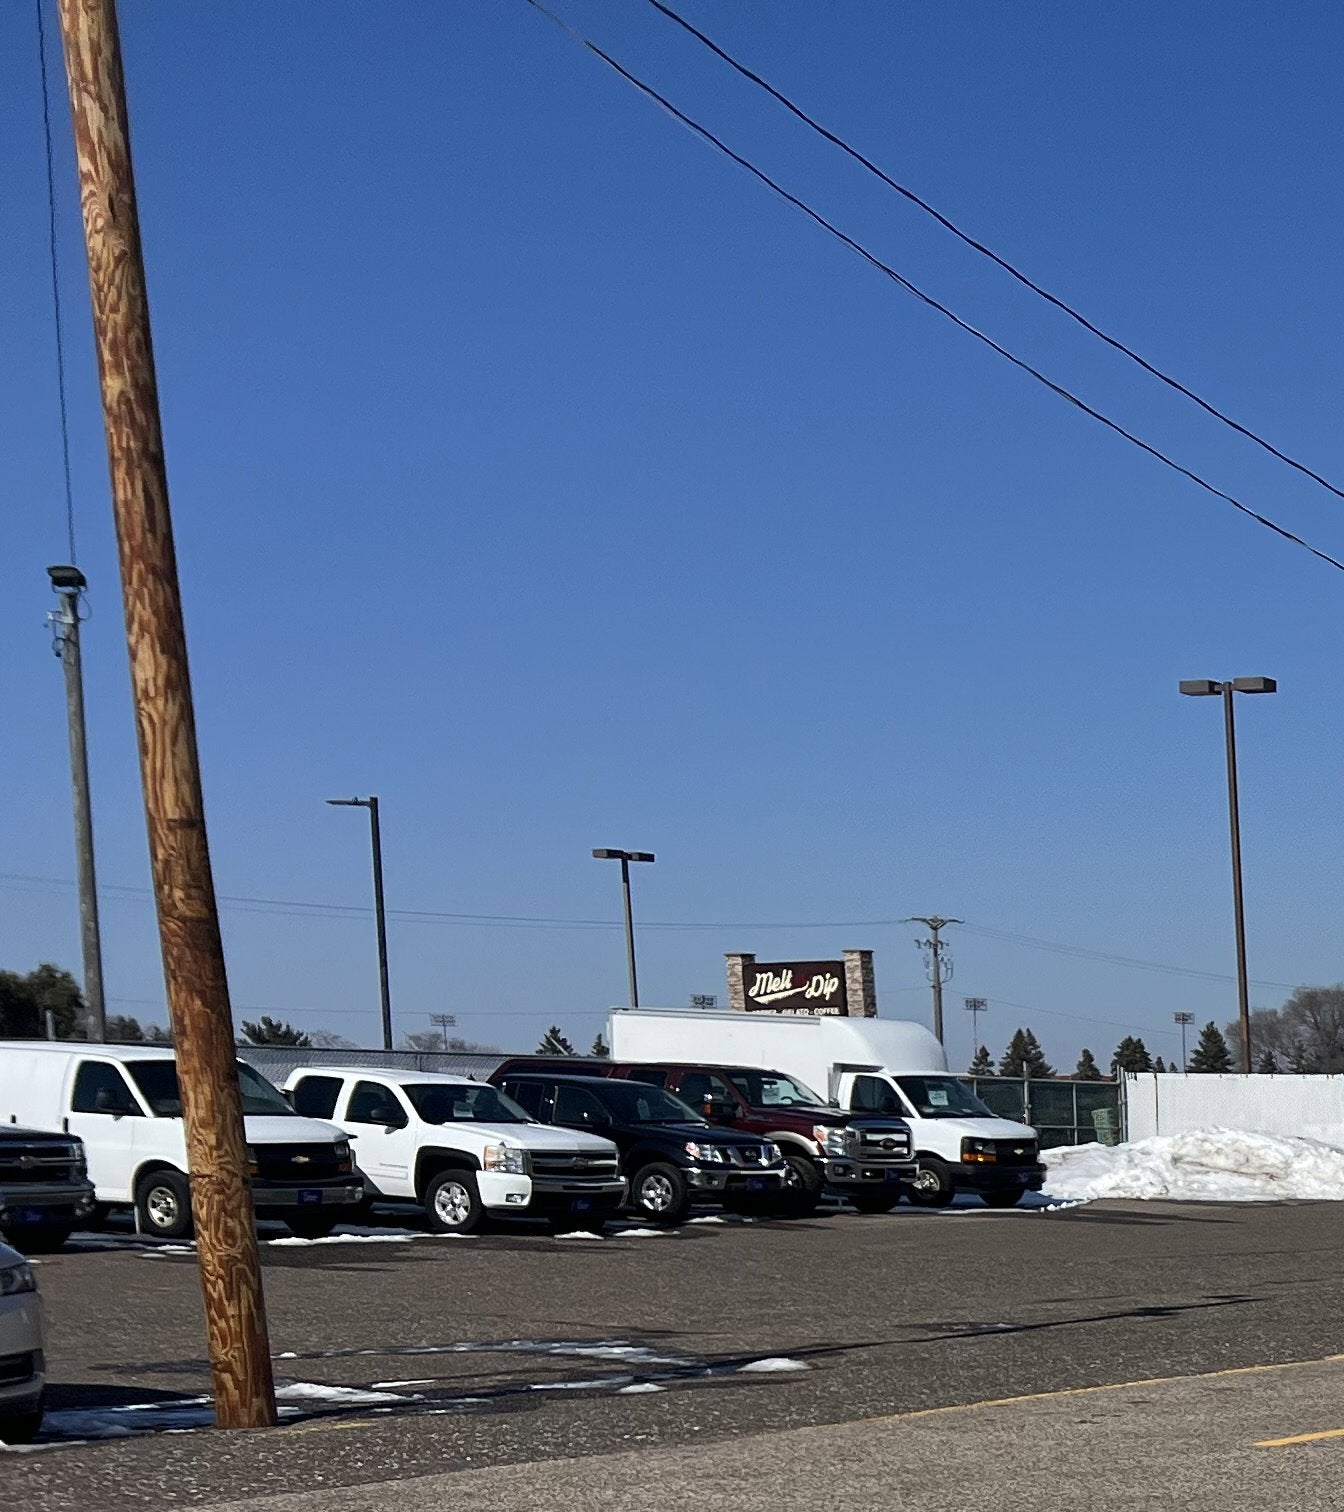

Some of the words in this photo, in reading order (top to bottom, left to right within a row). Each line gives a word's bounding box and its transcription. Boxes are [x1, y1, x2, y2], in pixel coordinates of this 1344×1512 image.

[749, 969, 793, 997] Melt
[804, 972, 840, 1001] Dip
[813, 1007, 840, 1015] COFFEE
